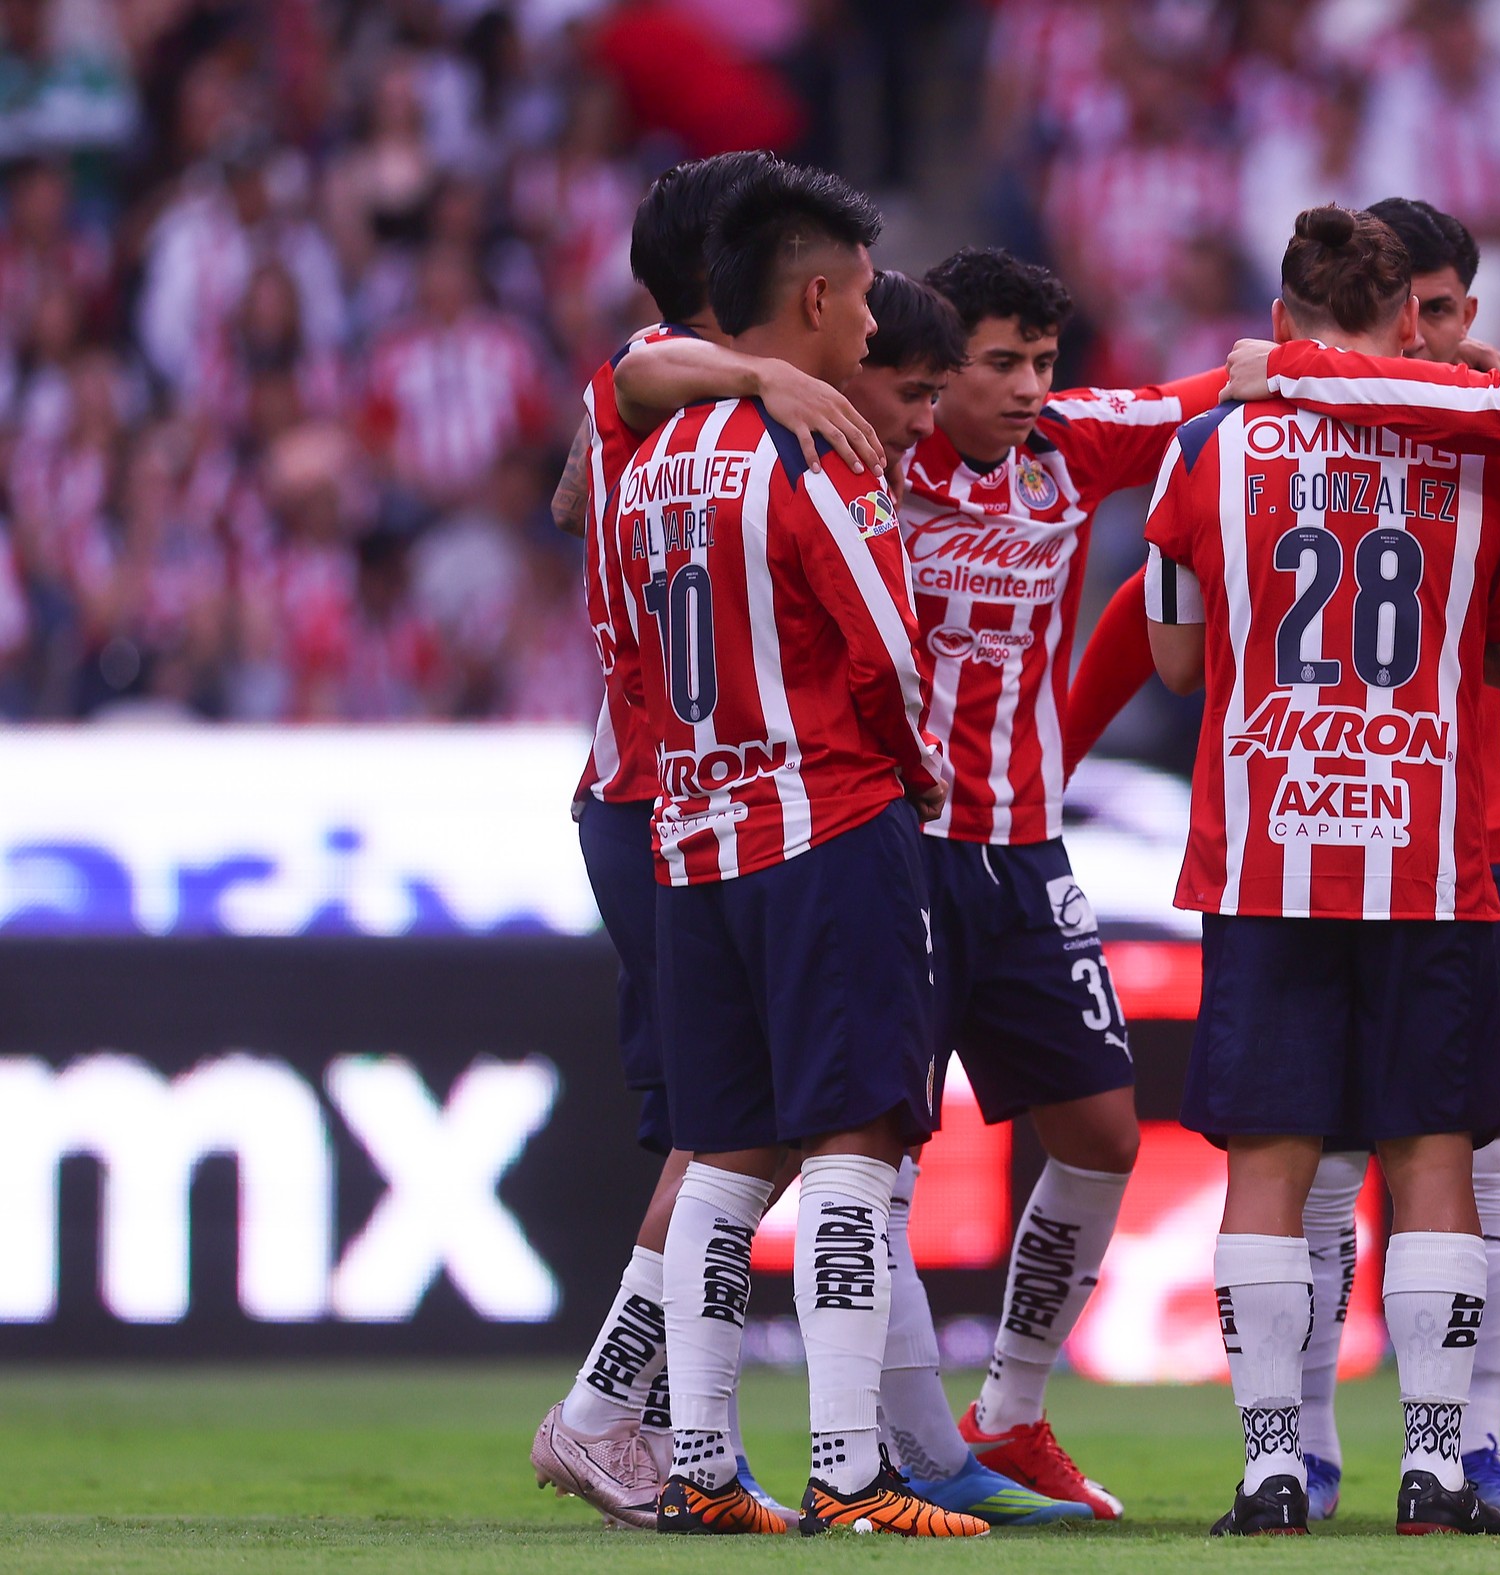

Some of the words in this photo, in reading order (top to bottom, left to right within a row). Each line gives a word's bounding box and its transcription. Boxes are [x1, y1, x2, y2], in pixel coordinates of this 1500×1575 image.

[625, 456, 745, 508] OMNILIFE
[1247, 473, 1278, 516] F.
[1290, 471, 1458, 523] GONZALEZ
[918, 565, 1057, 598] caliente.mx
[1272, 525, 1426, 689] 28
[642, 562, 718, 726] 10
[976, 649, 1010, 662] pago
[980, 632, 1032, 646] mercado
[1228, 696, 1450, 760] AKRON
[1274, 822, 1404, 840] CAPITAL
[1275, 780, 1404, 820] AXEN
[0, 1048, 563, 1325] mx
[702, 1223, 758, 1330] PERDURA
[814, 1205, 876, 1310] PERDURA
[994, 1213, 1082, 1342] PERDURA
[586, 1294, 667, 1402] PERDUR
